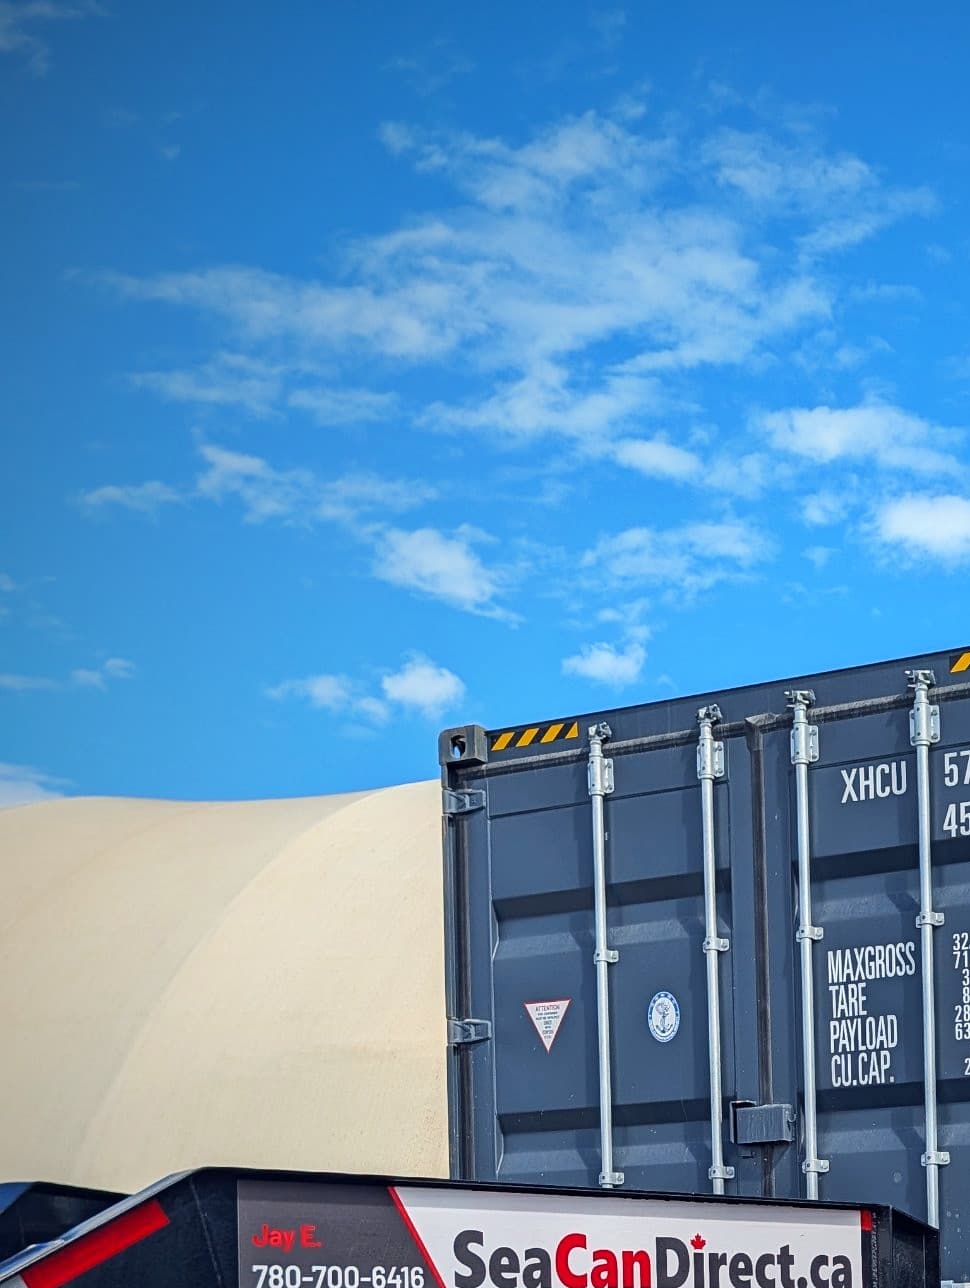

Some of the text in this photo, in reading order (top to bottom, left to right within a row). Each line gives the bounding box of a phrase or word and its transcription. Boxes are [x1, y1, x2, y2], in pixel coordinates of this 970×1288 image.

[840, 760, 907, 804] XHCU
[827, 941, 916, 984] MAXGROSS
[828, 981, 868, 1019] TARE
[829, 1014, 898, 1054] PAYLOAD
[831, 1050, 895, 1088] CU.CAP.
[252, 1223, 323, 1253] Jay E.
